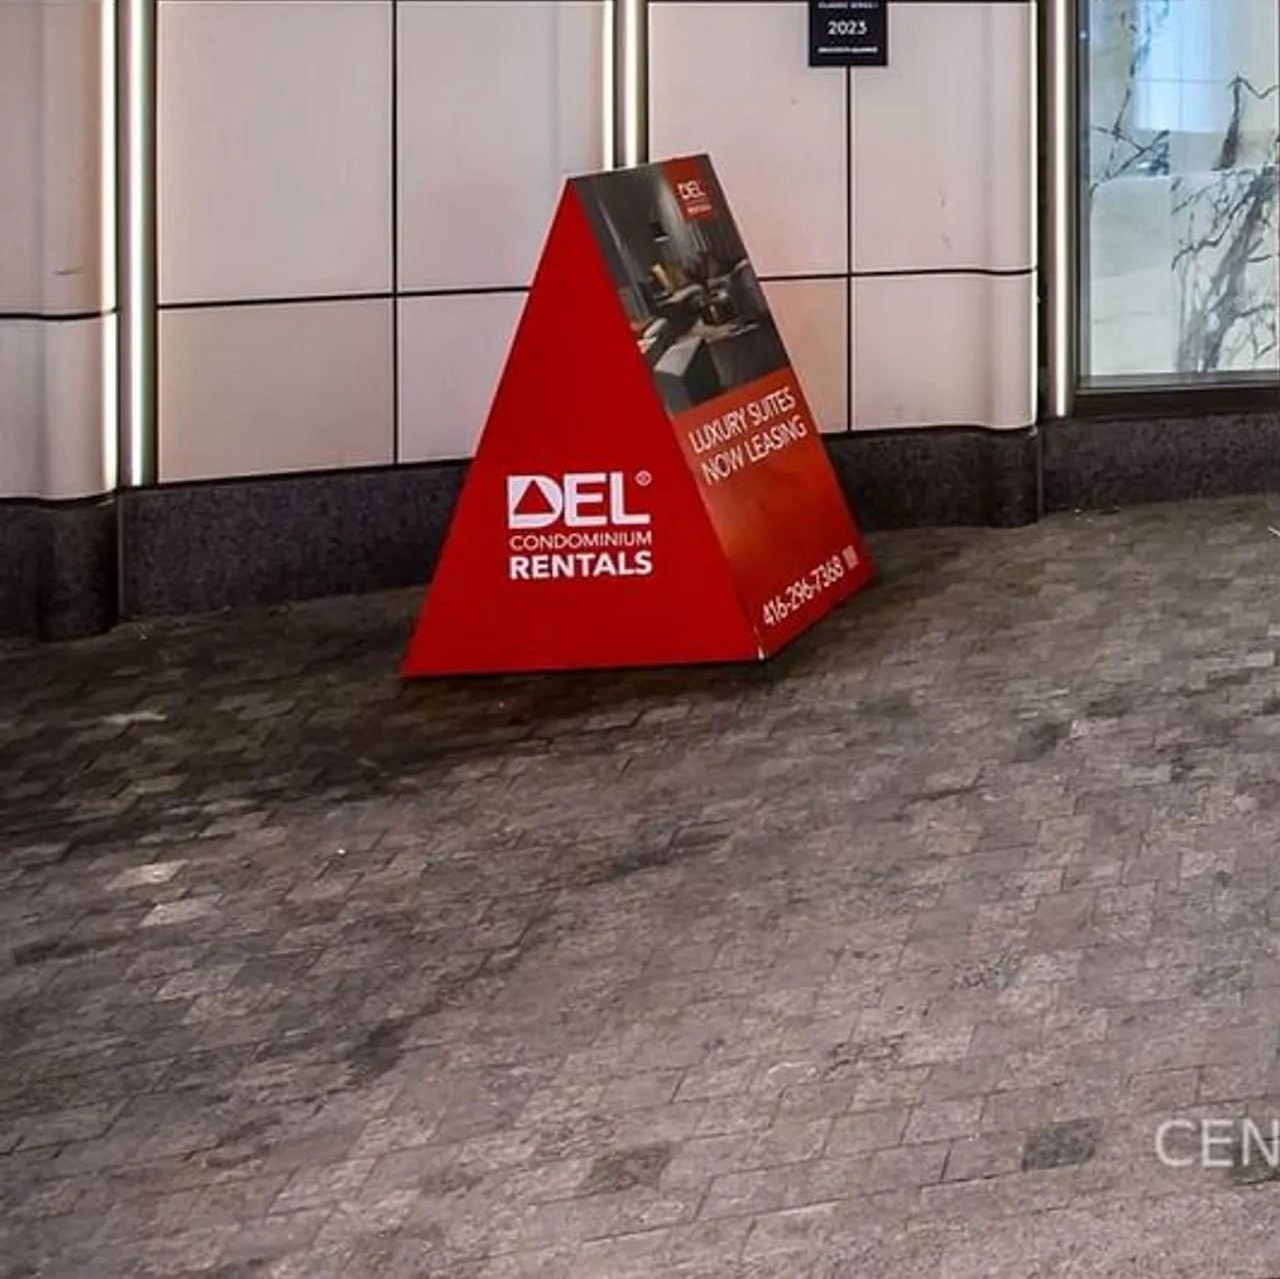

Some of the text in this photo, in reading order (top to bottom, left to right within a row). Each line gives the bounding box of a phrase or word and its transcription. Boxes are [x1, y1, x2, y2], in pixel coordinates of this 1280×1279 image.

[688, 385, 797, 454] LUXURY SUITES
[700, 414, 808, 486] NOW LEASING
[509, 530, 652, 552] CONDOMINIUM
[509, 550, 653, 581] RENTALS
